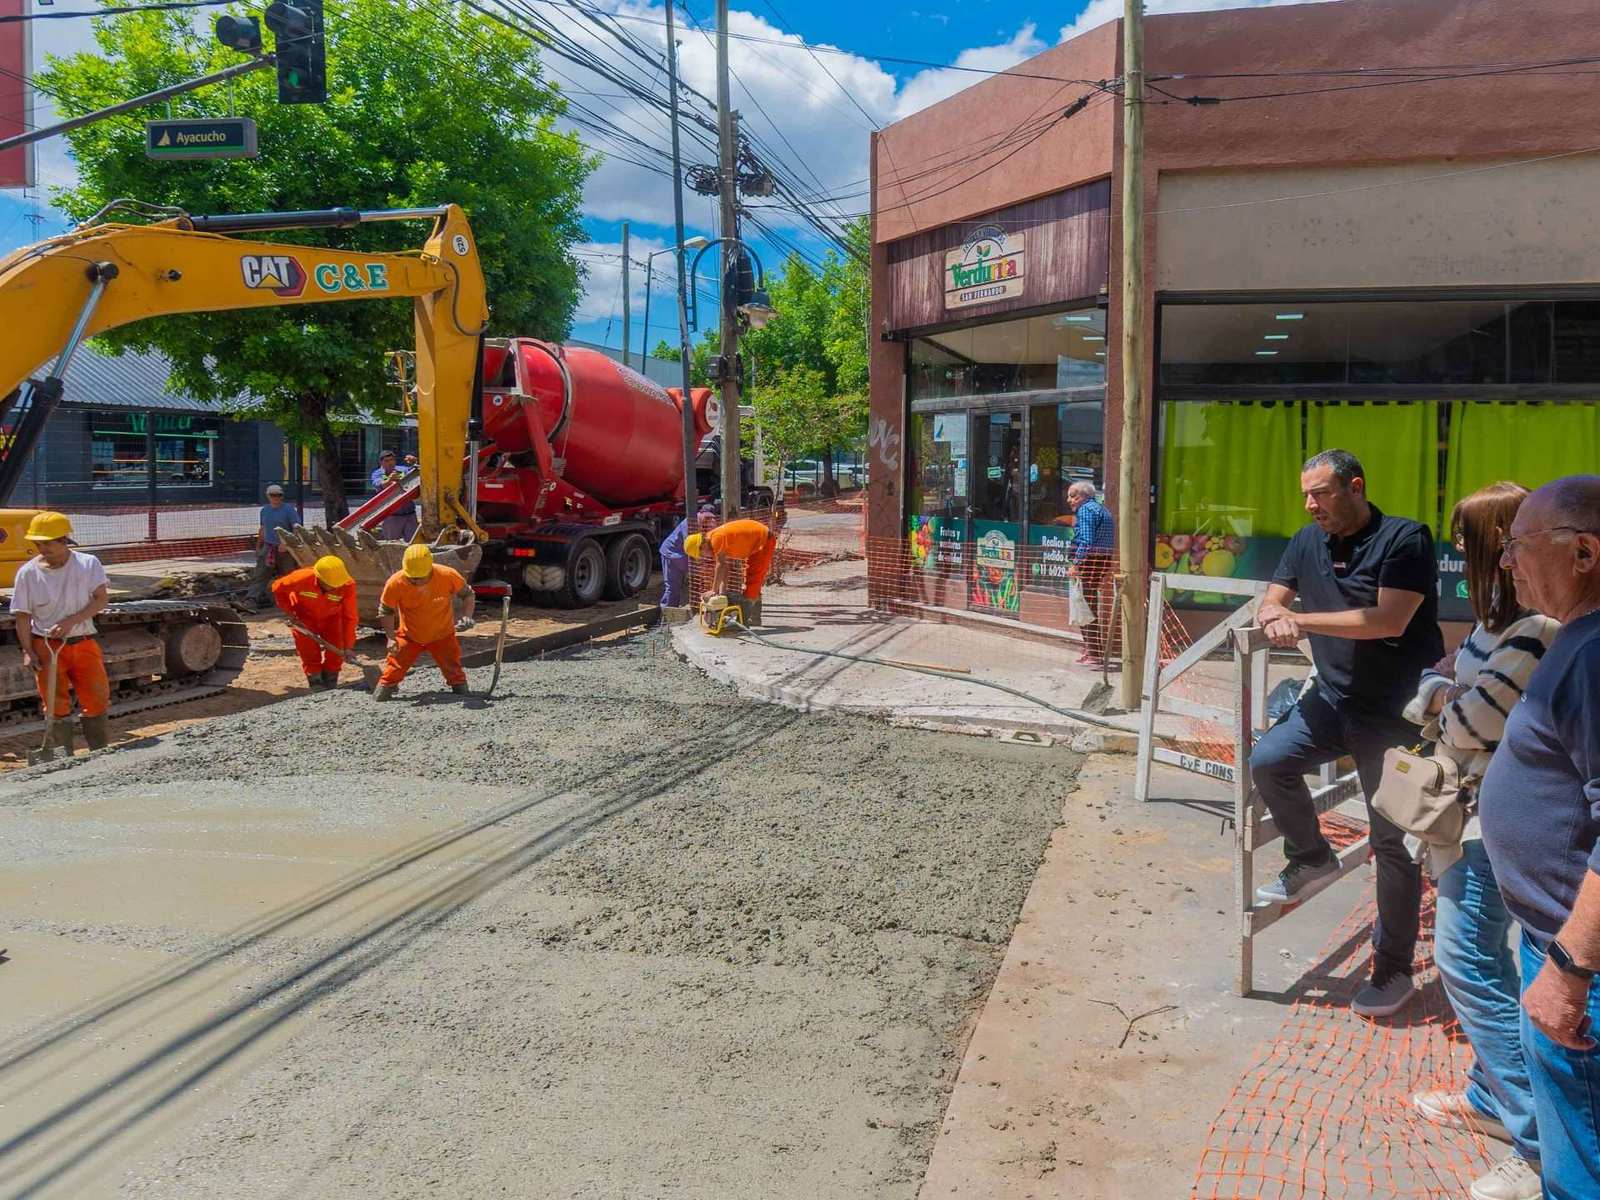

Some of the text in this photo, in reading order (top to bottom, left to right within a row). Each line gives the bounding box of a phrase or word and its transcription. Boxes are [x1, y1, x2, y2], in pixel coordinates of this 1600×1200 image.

[176, 131, 226, 146] Ayacucho
[241, 255, 291, 289] CAT
[314, 262, 389, 294] C&E
[951, 254, 1018, 289] Verdurita
[1041, 535, 1064, 549] Realice
[1205, 762, 1234, 780] CONS
